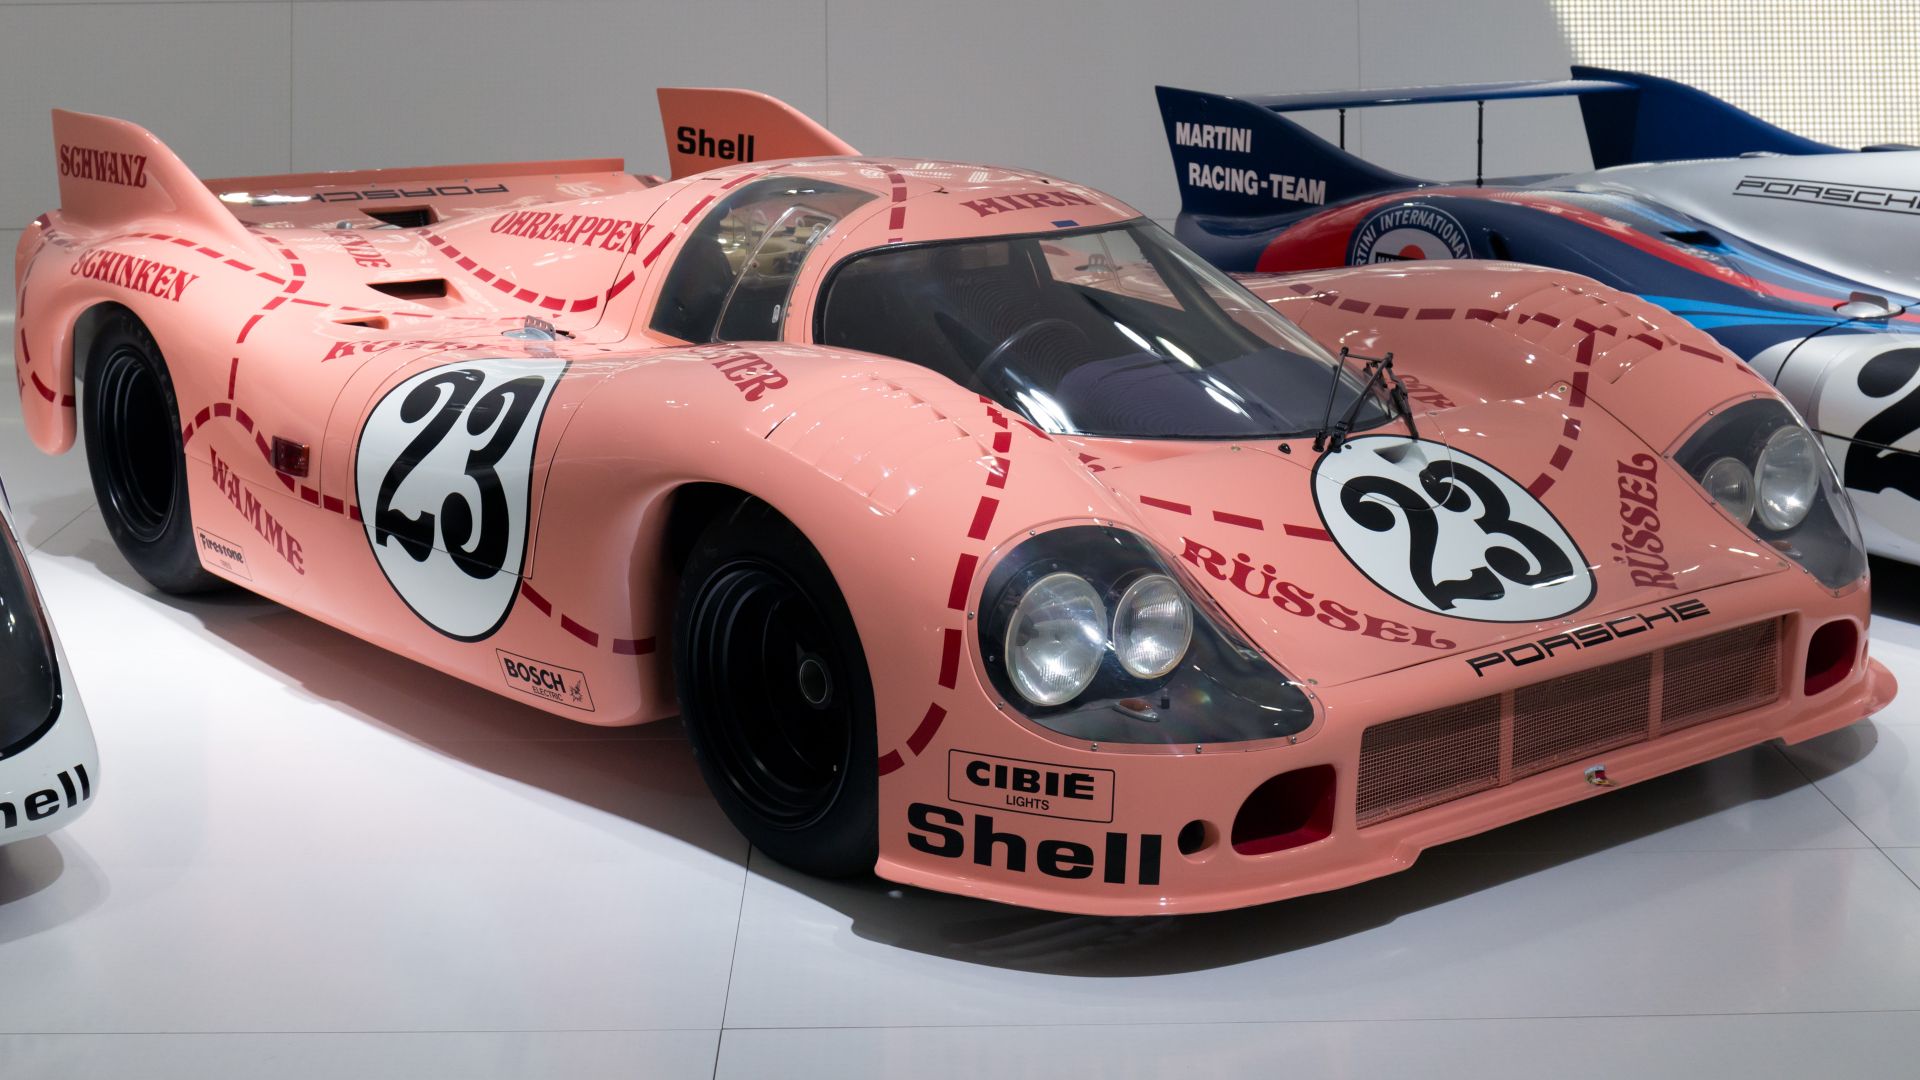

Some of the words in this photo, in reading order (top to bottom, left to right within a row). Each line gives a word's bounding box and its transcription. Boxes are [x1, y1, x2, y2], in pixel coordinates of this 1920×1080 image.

[677, 126, 755, 163] Shell
[1176, 122, 1252, 153] MARTINI
[60, 144, 148, 188] SCHWANZ
[1189, 162, 1326, 205] RACING-TEAM
[250, 184, 509, 207] PORSC
[959, 191, 1097, 218] HIRN
[1735, 180, 1920, 209] PORSCH
[489, 210, 656, 255] OHRLAPPEN
[70, 249, 200, 302] SCHINKEN
[375, 369, 546, 580] 23
[209, 444, 305, 576] WAMME
[199, 532, 245, 564] Firestone
[1340, 460, 1574, 611] 23
[1179, 536, 1457, 650] RÜSSEL
[1465, 598, 1711, 678] PORSCHE
[503, 657, 567, 694] BOSCH
[531, 685, 565, 702] ELECTRIC
[1006, 795, 1050, 811] LIGHTS
[907, 802, 1162, 886] Shell
